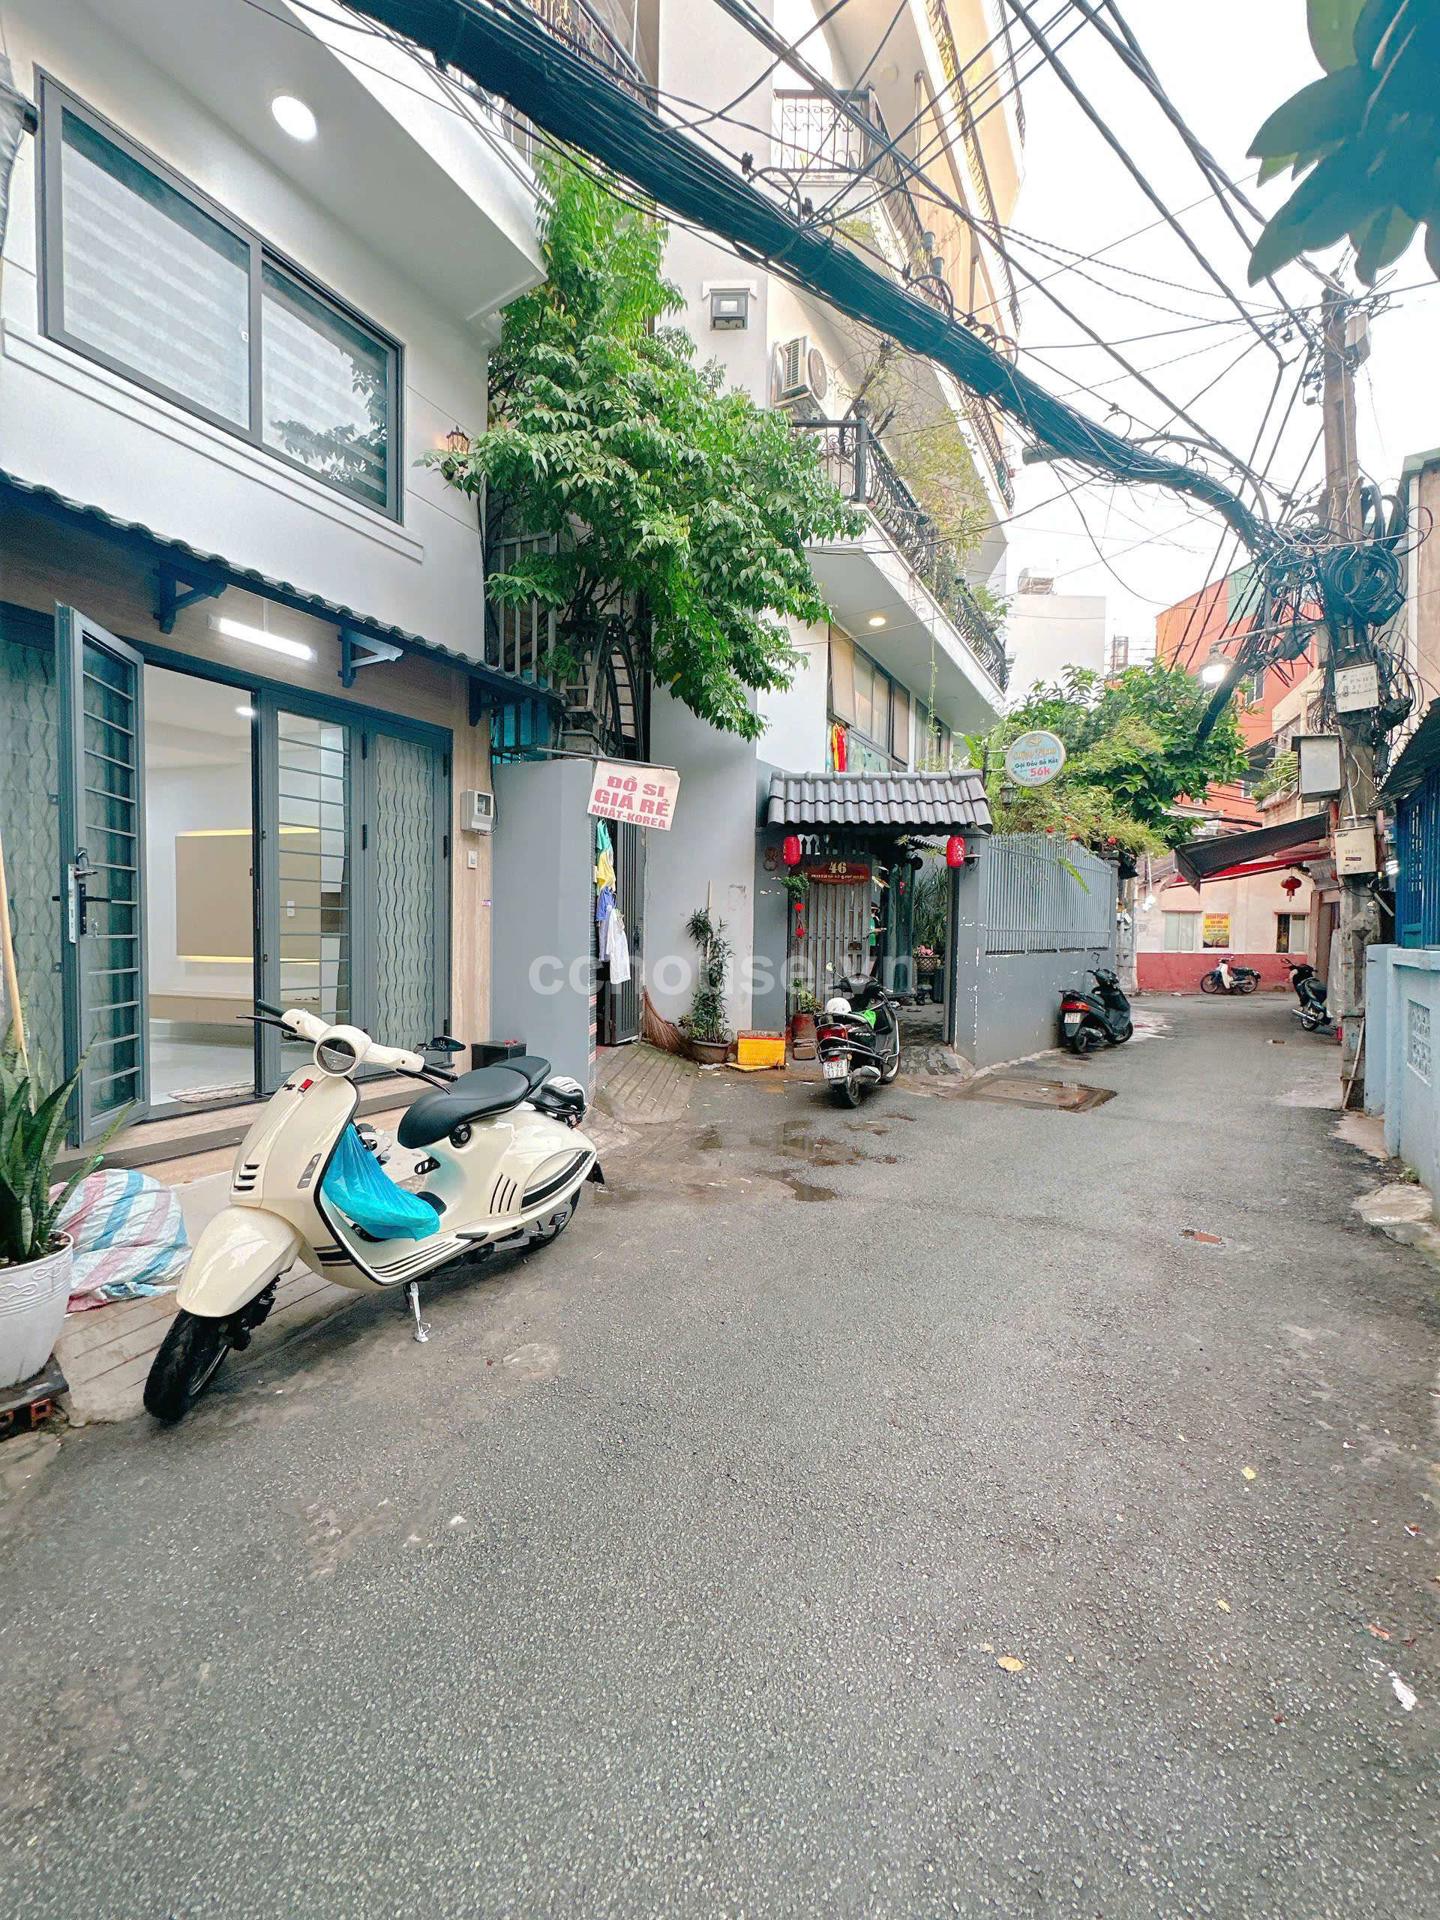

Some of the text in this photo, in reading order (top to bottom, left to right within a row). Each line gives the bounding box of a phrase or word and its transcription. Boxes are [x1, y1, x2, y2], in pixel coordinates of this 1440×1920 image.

[607, 775, 665, 797] ĐỒ SI
[594, 788, 633, 810] GIÁ
[828, 861, 847, 874] 46
